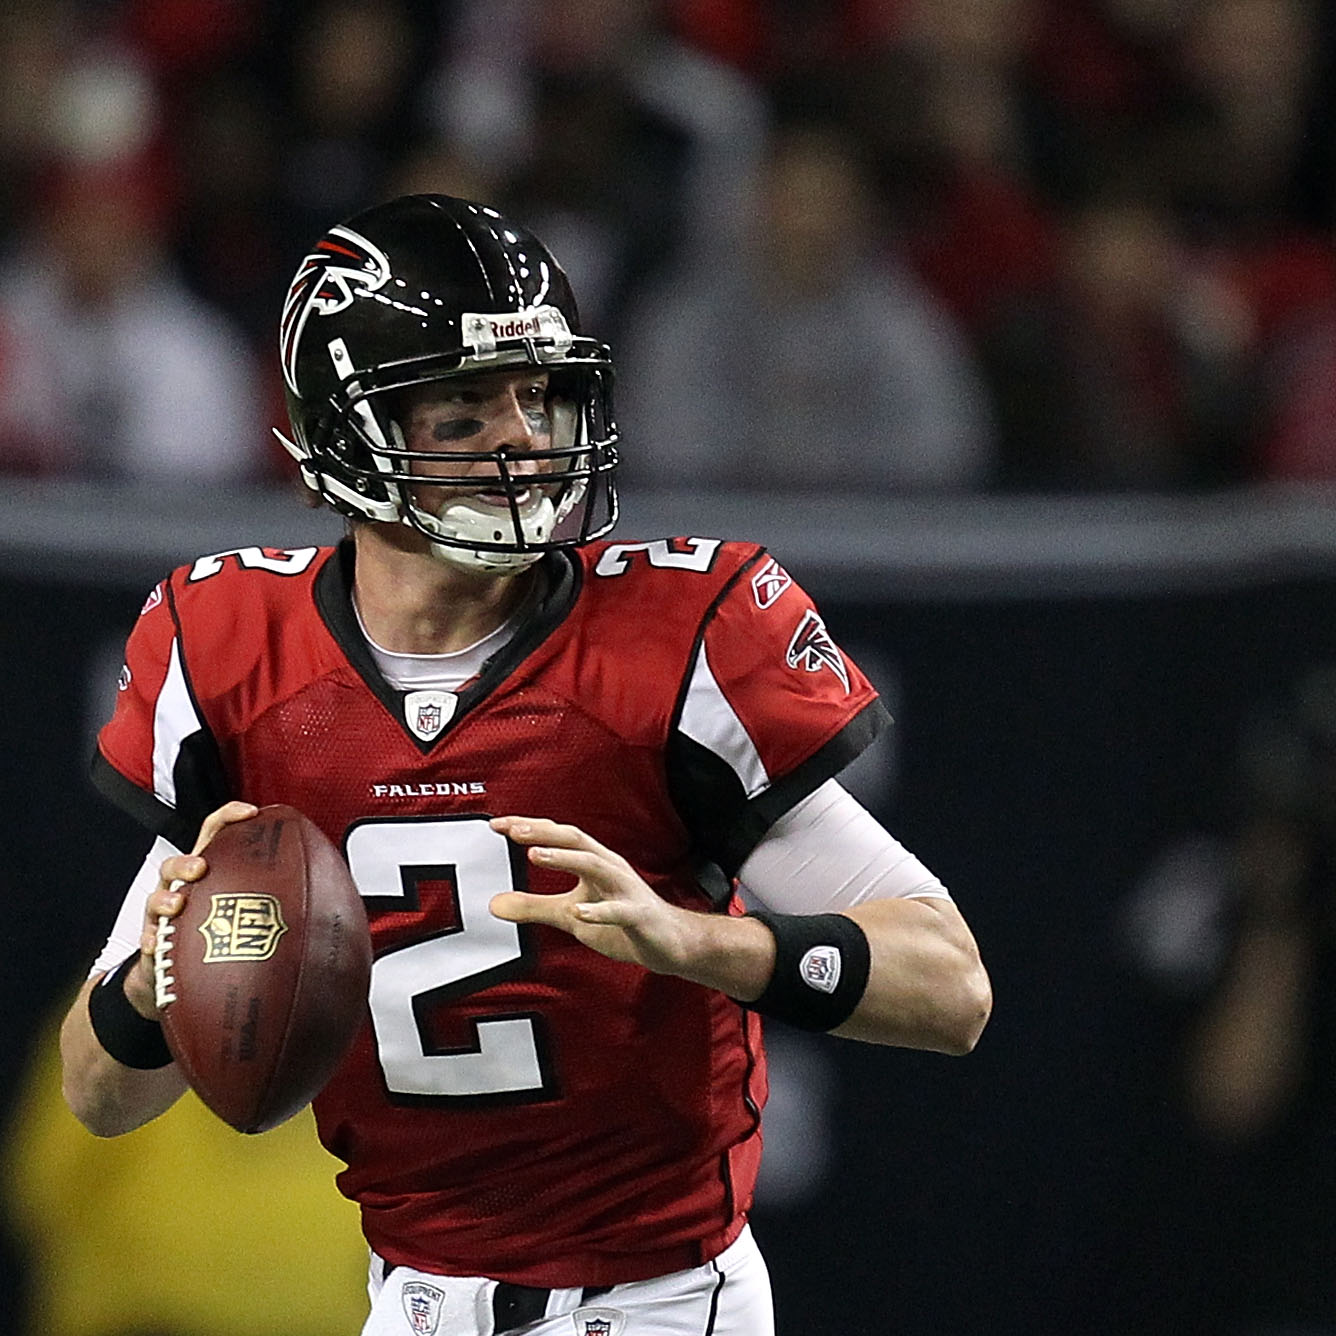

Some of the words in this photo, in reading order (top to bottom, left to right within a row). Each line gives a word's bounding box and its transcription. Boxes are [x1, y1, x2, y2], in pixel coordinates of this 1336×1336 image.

[490, 316, 541, 338] Riddell
[188, 545, 318, 583] 2
[595, 537, 722, 577] 2
[372, 782, 486, 797] FALCONS
[235, 901, 271, 952] NFL
[345, 816, 545, 1098] 2
